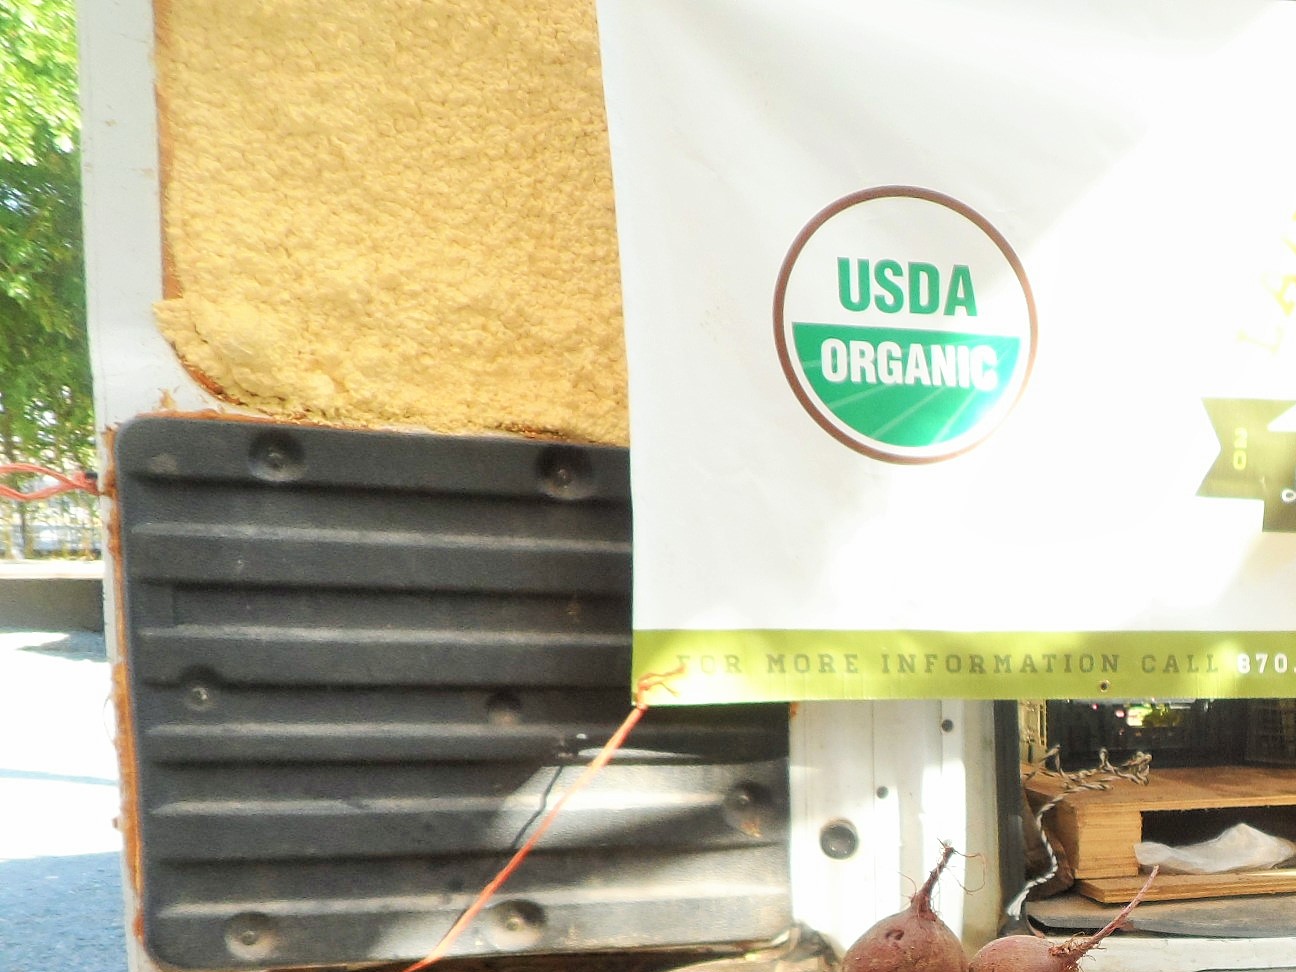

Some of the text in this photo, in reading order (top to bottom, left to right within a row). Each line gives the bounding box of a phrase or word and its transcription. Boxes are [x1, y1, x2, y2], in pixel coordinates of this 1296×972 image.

[836, 256, 978, 317] USDA
[820, 338, 999, 392] ORGANIC
[766, 653, 860, 675] MORE
[881, 653, 1121, 675] INFORMATION
[1141, 653, 1219, 674] CALL
